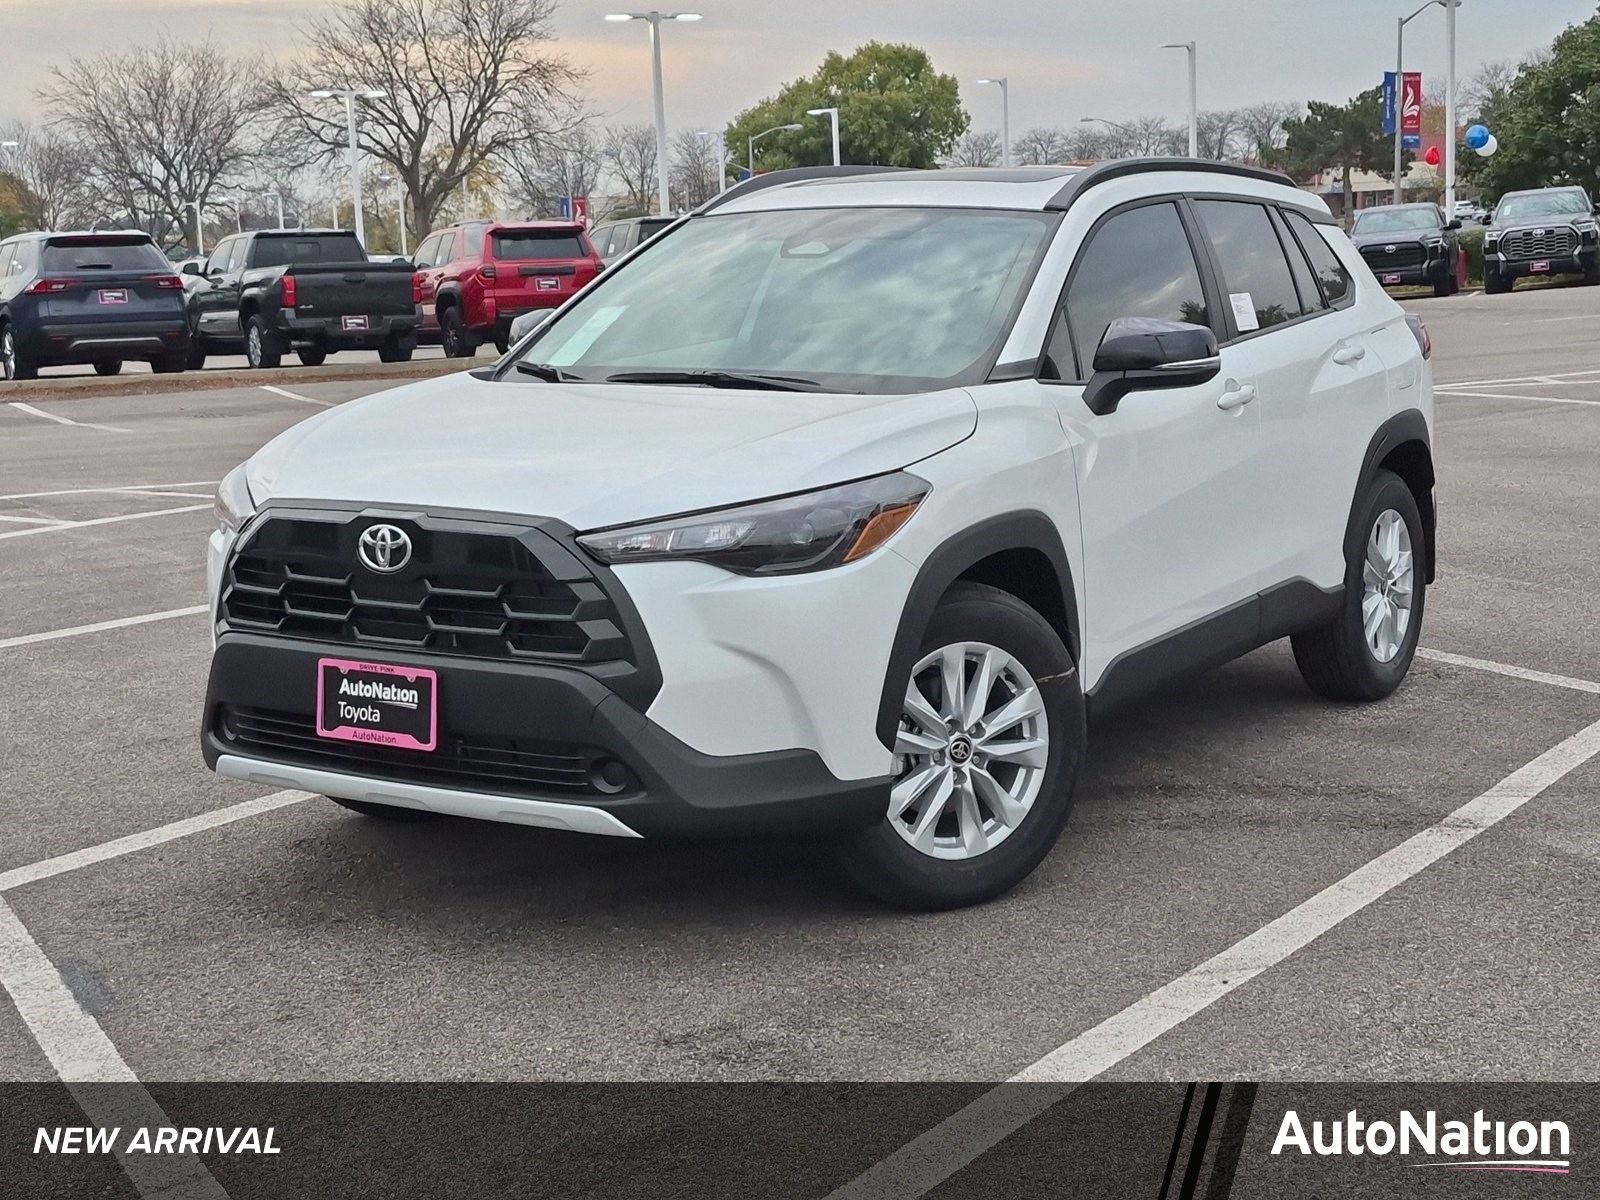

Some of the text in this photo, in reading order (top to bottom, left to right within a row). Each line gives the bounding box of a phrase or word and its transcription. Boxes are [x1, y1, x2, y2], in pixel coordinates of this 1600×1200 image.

[359, 663, 395, 673] DRIVE PINK
[339, 678, 419, 704] AutoNation
[338, 701, 380, 723] Toyota
[352, 730, 397, 745] AutoNation
